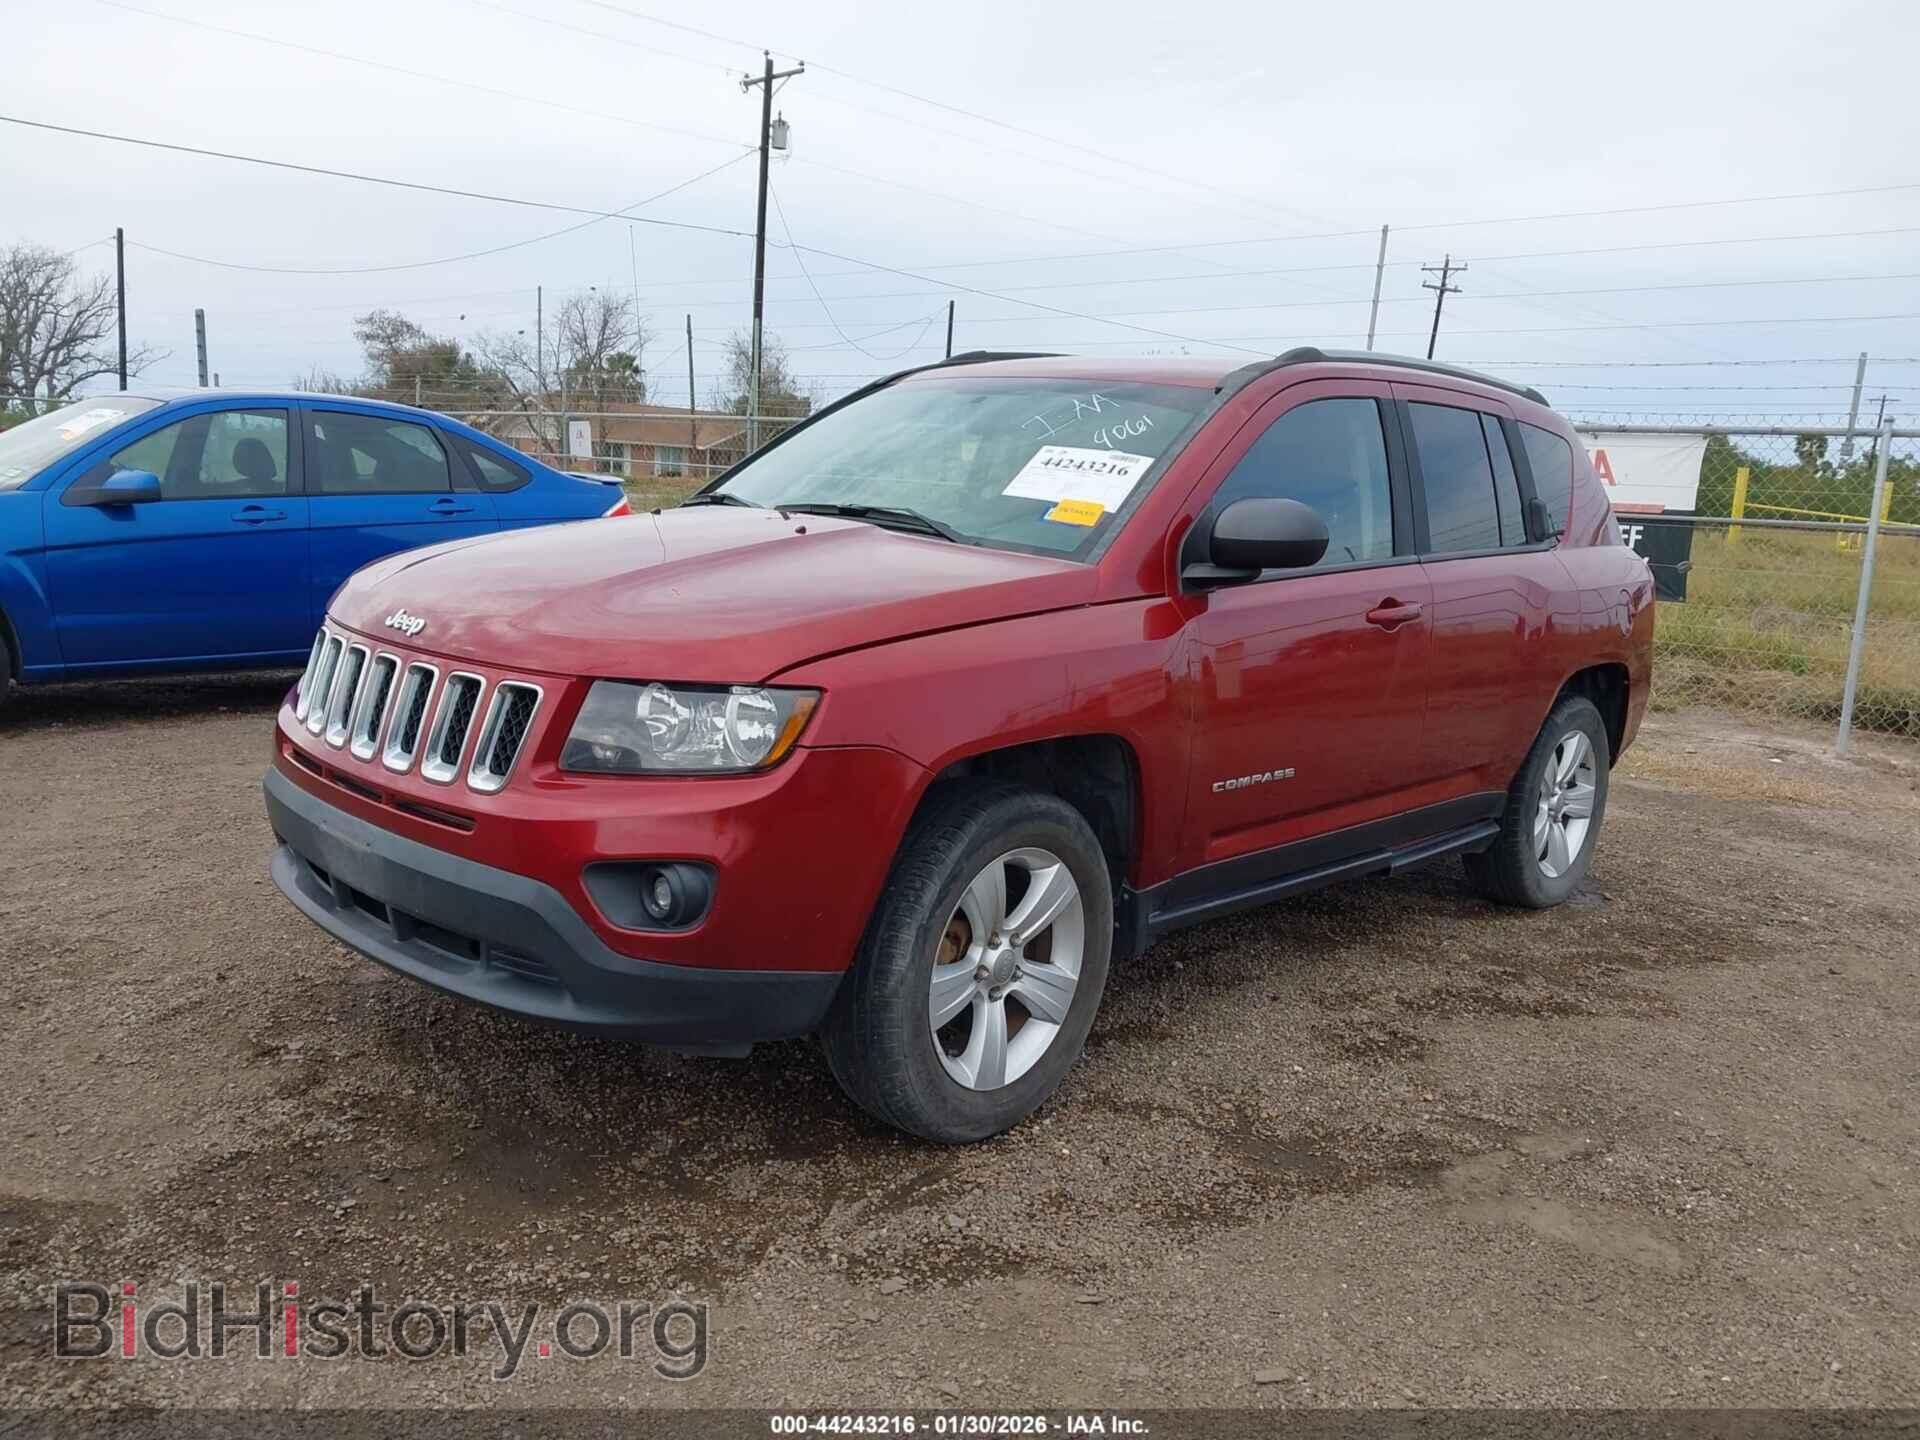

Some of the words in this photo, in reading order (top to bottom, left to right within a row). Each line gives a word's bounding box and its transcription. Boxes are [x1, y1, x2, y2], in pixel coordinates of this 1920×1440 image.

[1041, 457, 1128, 476] 44243216
[385, 608, 426, 637] Jeep
[1212, 767, 1296, 793] COMPASS
